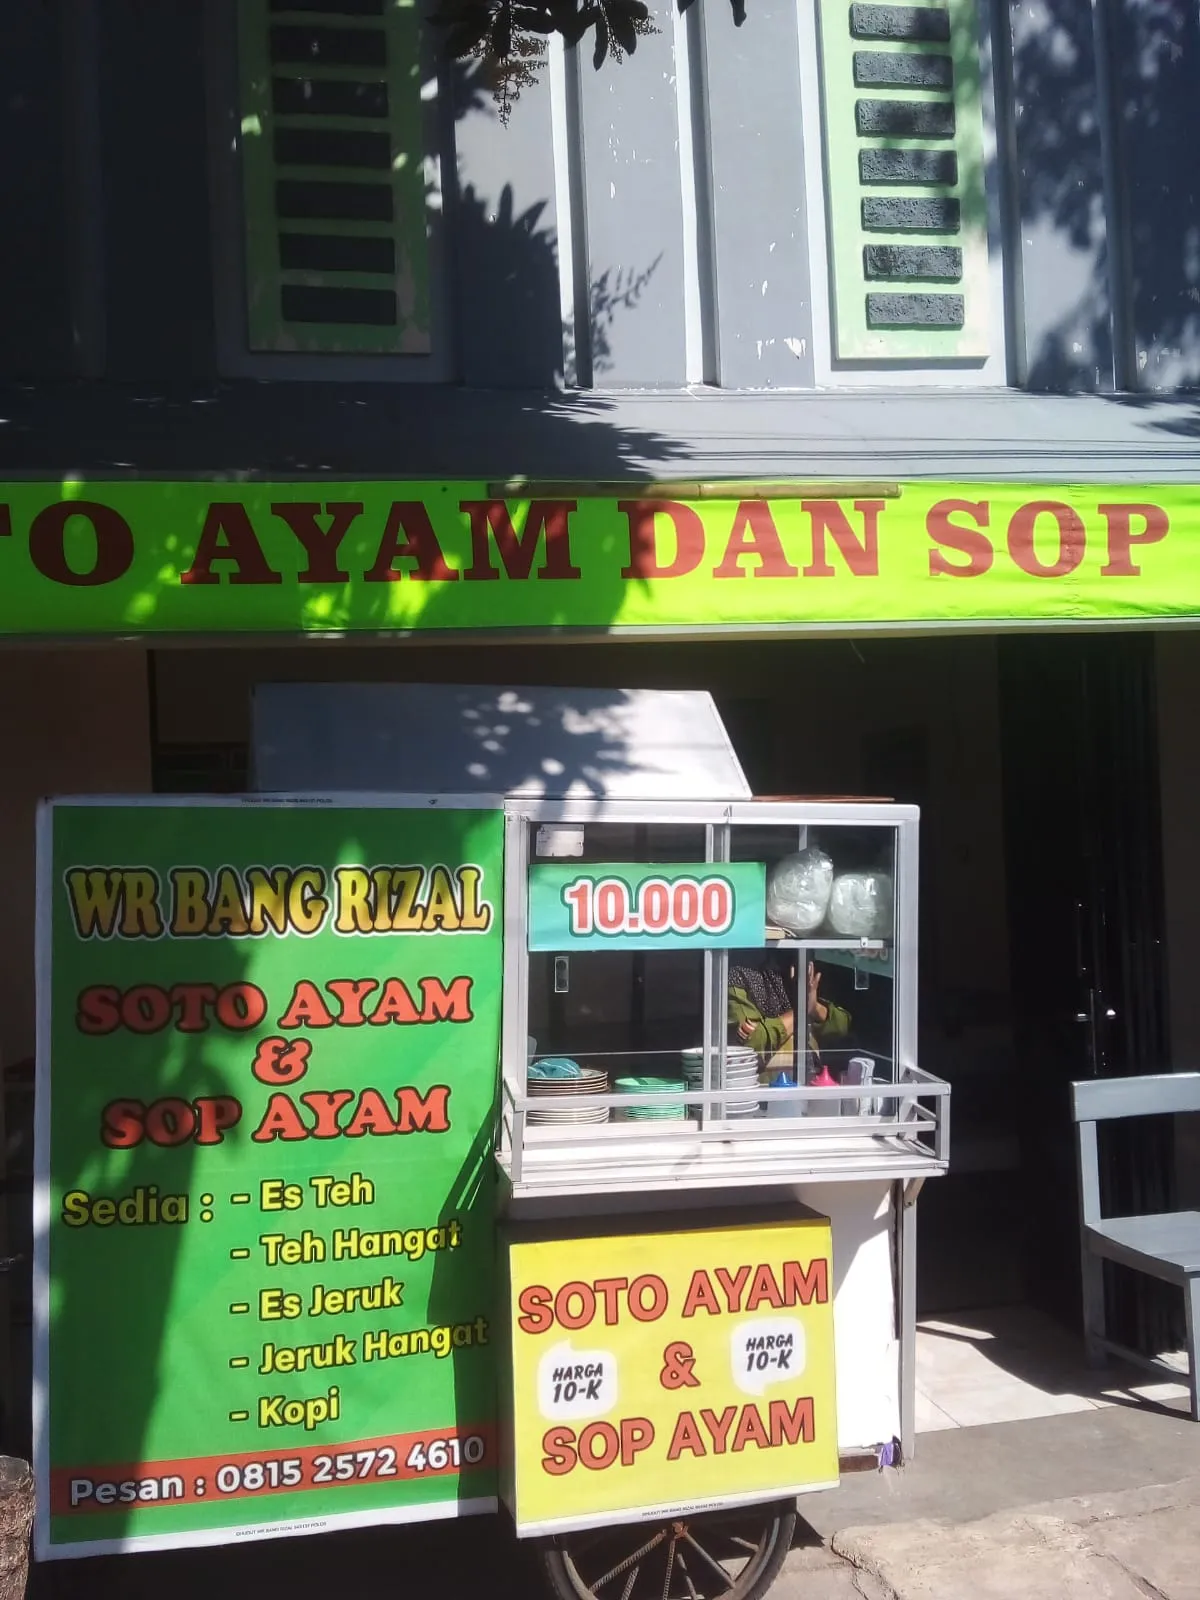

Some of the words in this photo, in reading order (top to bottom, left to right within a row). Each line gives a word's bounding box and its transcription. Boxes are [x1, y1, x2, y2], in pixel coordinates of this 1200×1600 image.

[0, 499, 134, 586] O
[181, 499, 582, 584] AYAM
[617, 499, 886, 579] DAN
[925, 498, 1170, 578] SOP
[66, 865, 162, 940] WR
[169, 865, 328, 938] BANG
[333, 865, 492, 936] RIZAL
[564, 879, 732, 933] 10.000
[76, 981, 268, 1035] SOTO
[278, 976, 474, 1029] AYAM
[252, 1036, 312, 1085] &
[102, 1095, 242, 1148] SOP
[252, 1085, 452, 1141] AYAM
[62, 1186, 189, 1226] Sedia
[260, 1180, 302, 1211] Es
[310, 1173, 375, 1207] Teh
[260, 1232, 325, 1265] Teh
[334, 1219, 462, 1261] Hangat
[259, 1290, 301, 1320] Es
[309, 1278, 404, 1316] Jeruk
[518, 1274, 669, 1334] SOTO
[681, 1258, 829, 1318] AYAM
[258, 1335, 356, 1375] Jeruk
[364, 1316, 489, 1360] Hangat
[659, 1341, 701, 1390] &
[746, 1333, 793, 1352] HARGA
[746, 1348, 793, 1371] 10-K
[552, 1362, 603, 1382] HARGA
[553, 1379, 602, 1403] 10-K
[258, 1386, 340, 1429] Kopi
[541, 1417, 655, 1476] SOP
[667, 1397, 814, 1460] AYAM
[70, 1474, 184, 1506] Pesan
[216, 1458, 301, 1494] 0815
[312, 1447, 398, 1483] 2572
[406, 1435, 486, 1471] 4610
